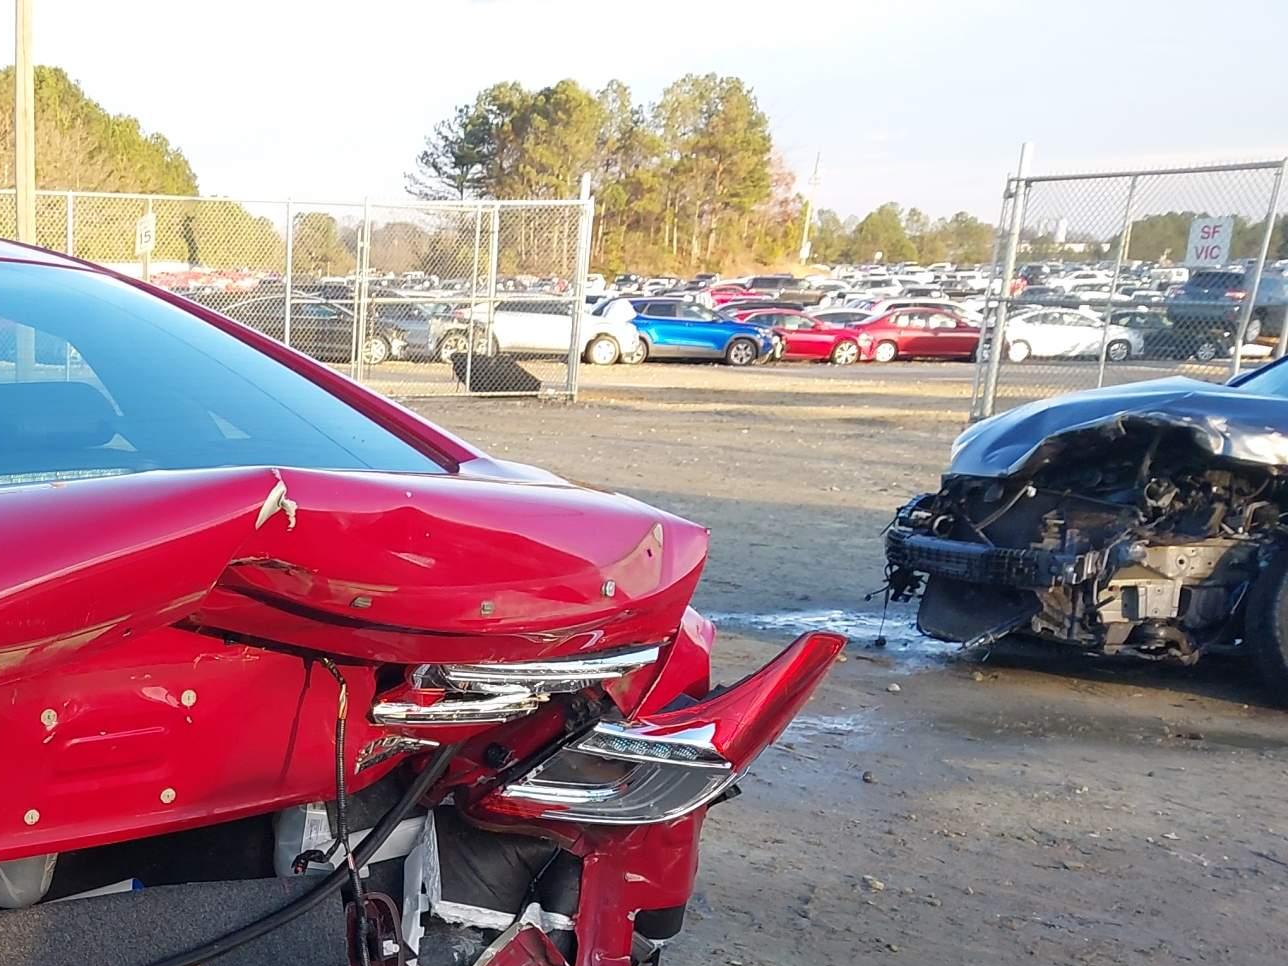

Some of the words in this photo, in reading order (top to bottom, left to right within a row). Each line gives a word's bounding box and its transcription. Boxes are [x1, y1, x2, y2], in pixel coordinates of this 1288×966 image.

[139, 230, 152, 245] 15
[1200, 224, 1223, 240] SF
[1194, 245, 1221, 261] VIC
